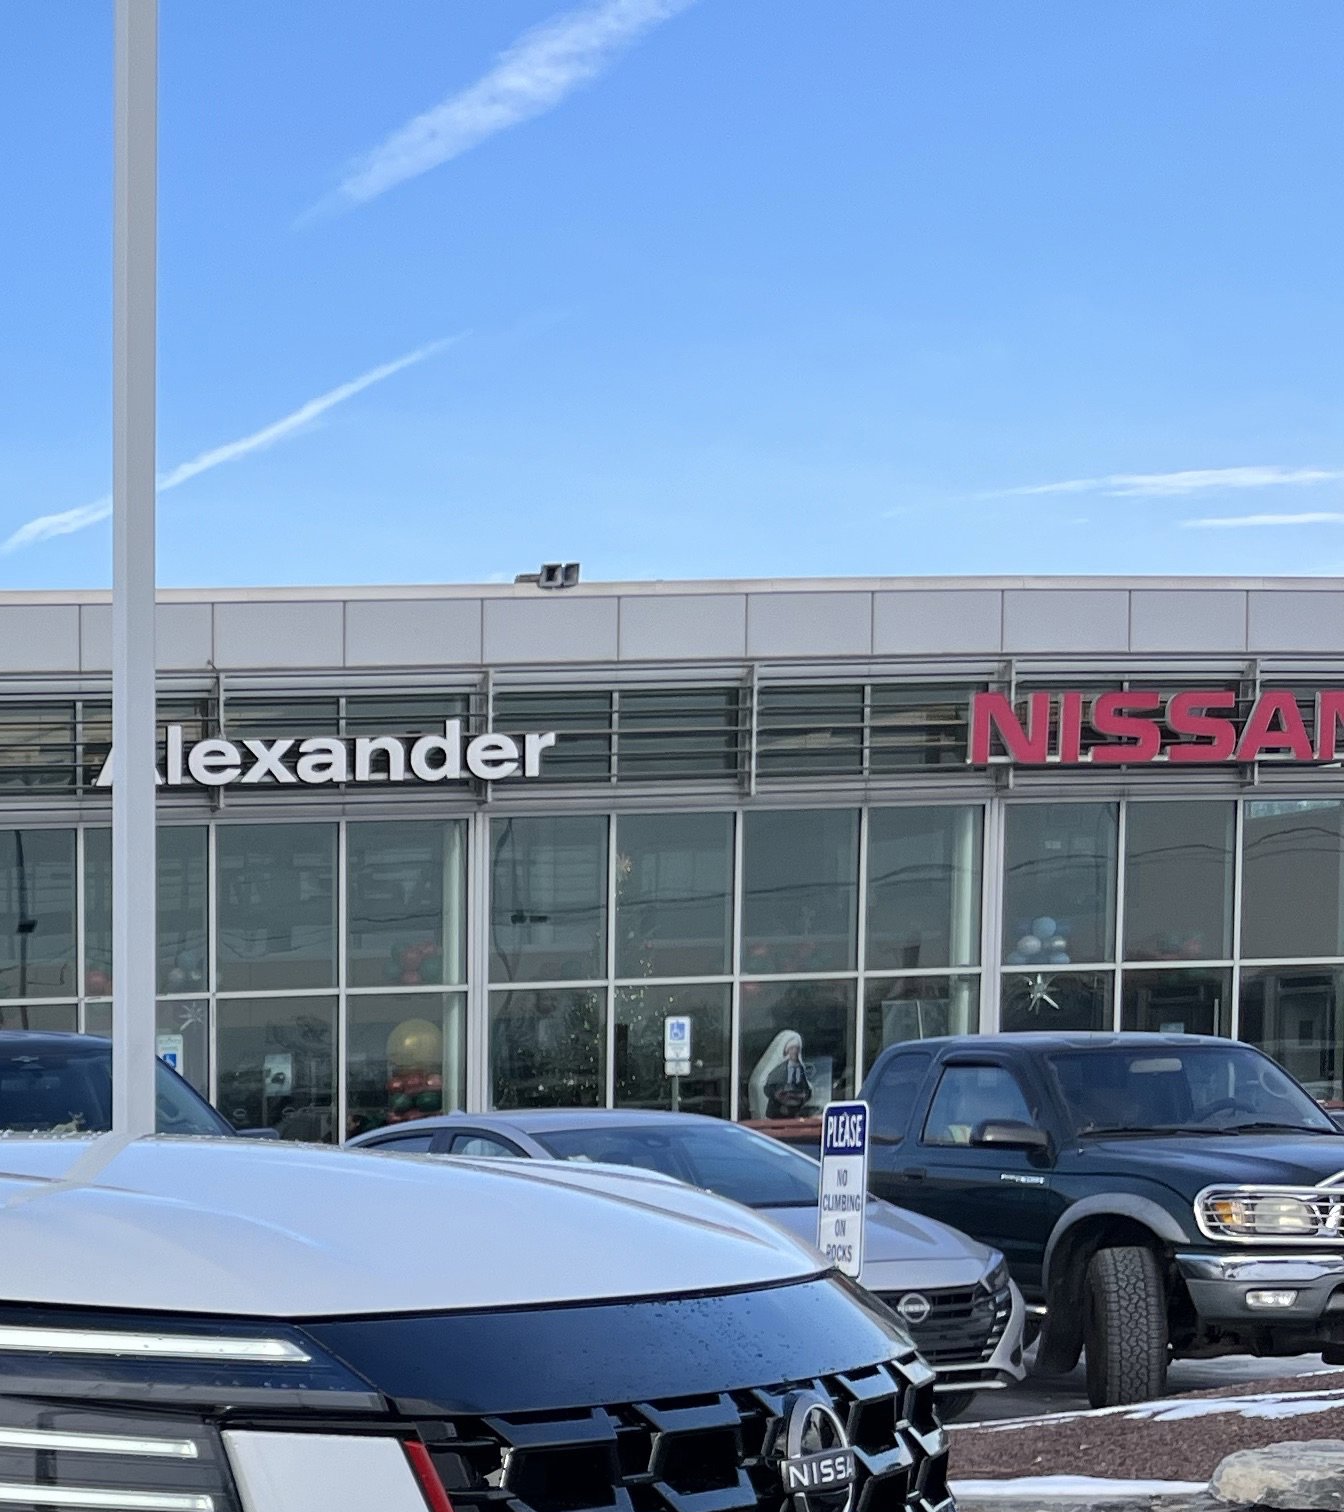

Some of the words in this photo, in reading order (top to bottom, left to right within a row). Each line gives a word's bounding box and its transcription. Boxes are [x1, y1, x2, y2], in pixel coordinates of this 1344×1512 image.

[827, 1113, 863, 1149] PLEASE
[836, 1169, 848, 1187] NO
[822, 1194, 861, 1212] CLIMBING
[834, 1219, 846, 1238] ON
[788, 1456, 853, 1488] NISSA
